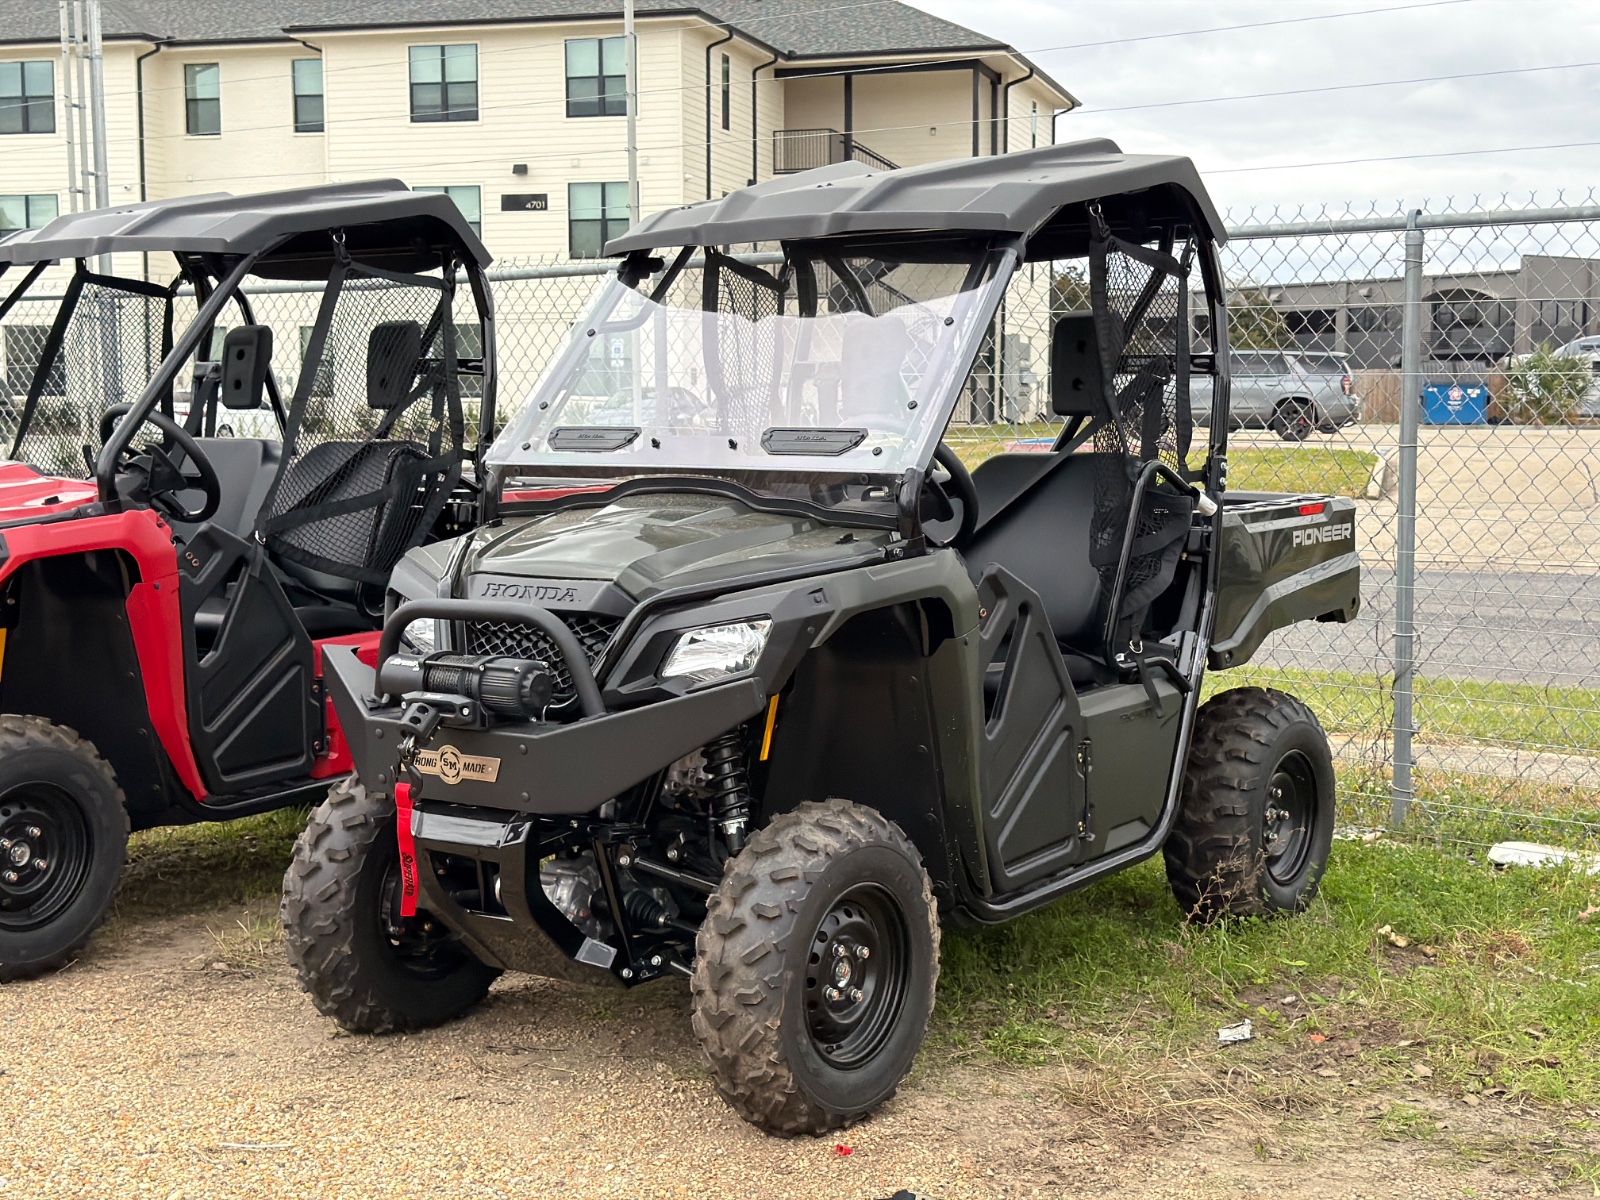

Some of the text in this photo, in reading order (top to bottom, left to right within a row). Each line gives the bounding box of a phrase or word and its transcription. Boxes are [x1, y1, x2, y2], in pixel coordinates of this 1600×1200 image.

[525, 201, 546, 209] 4701
[1292, 522, 1352, 548] PIONEER
[480, 582, 579, 602] HONDA
[414, 756, 438, 768] RONG
[462, 761, 487, 774] MADE
